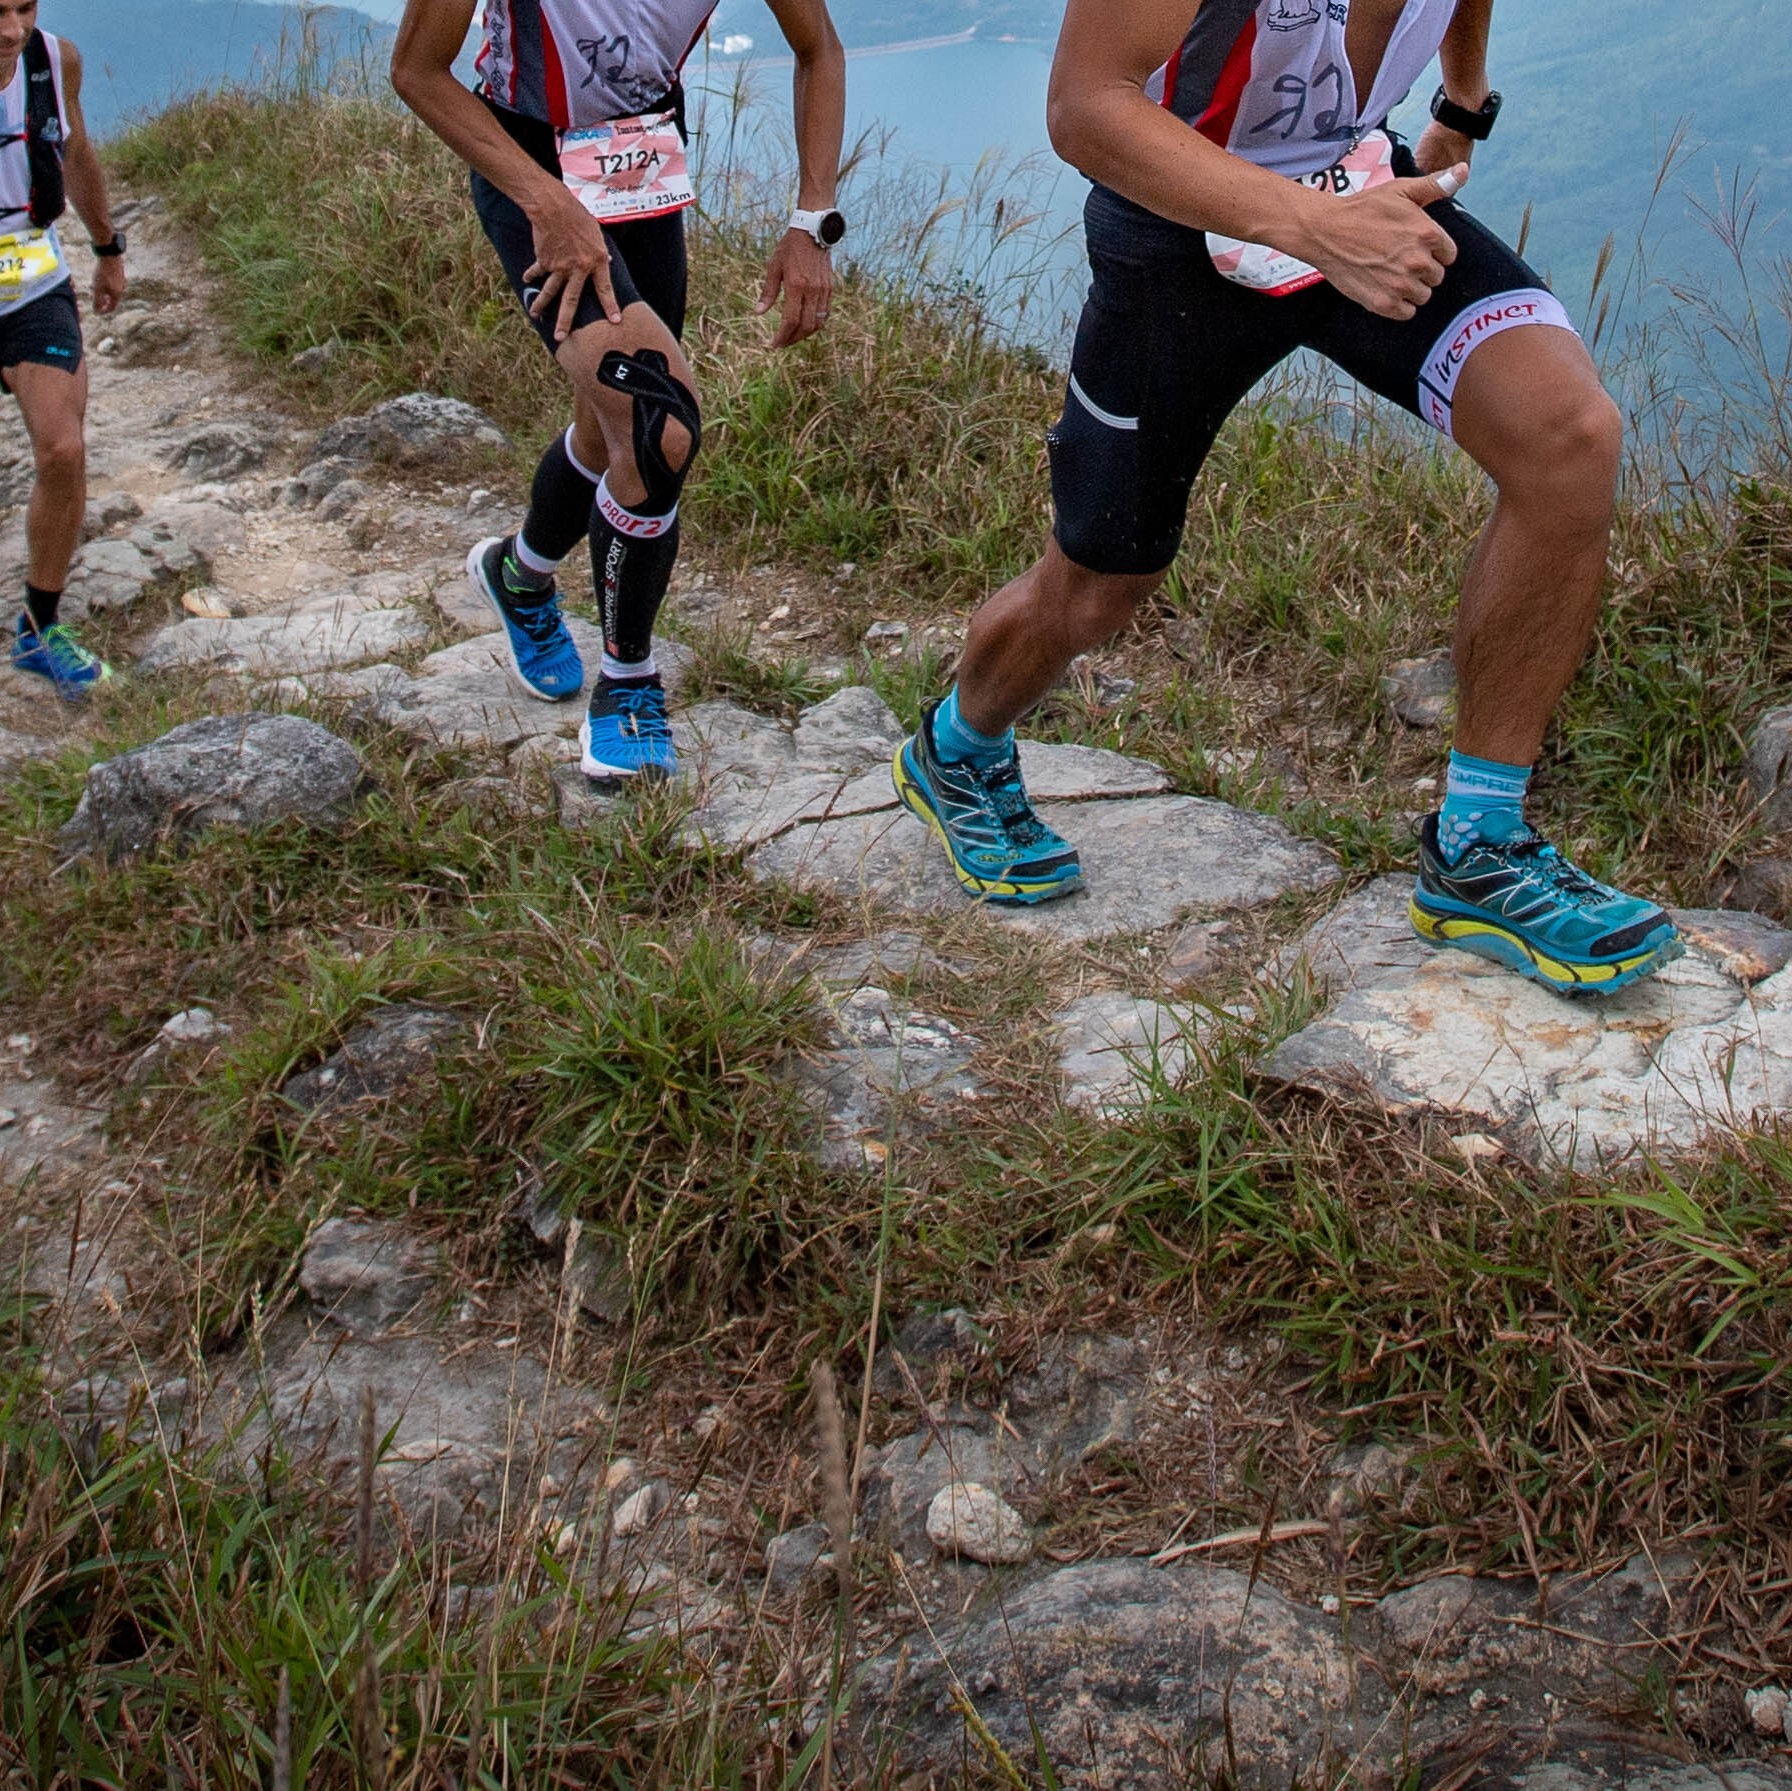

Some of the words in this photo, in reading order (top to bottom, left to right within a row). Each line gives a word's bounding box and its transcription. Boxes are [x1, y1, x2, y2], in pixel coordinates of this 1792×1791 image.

[594, 148, 660, 175] T212A
[656, 192, 691, 206] 23km
[615, 364, 629, 380] KT
